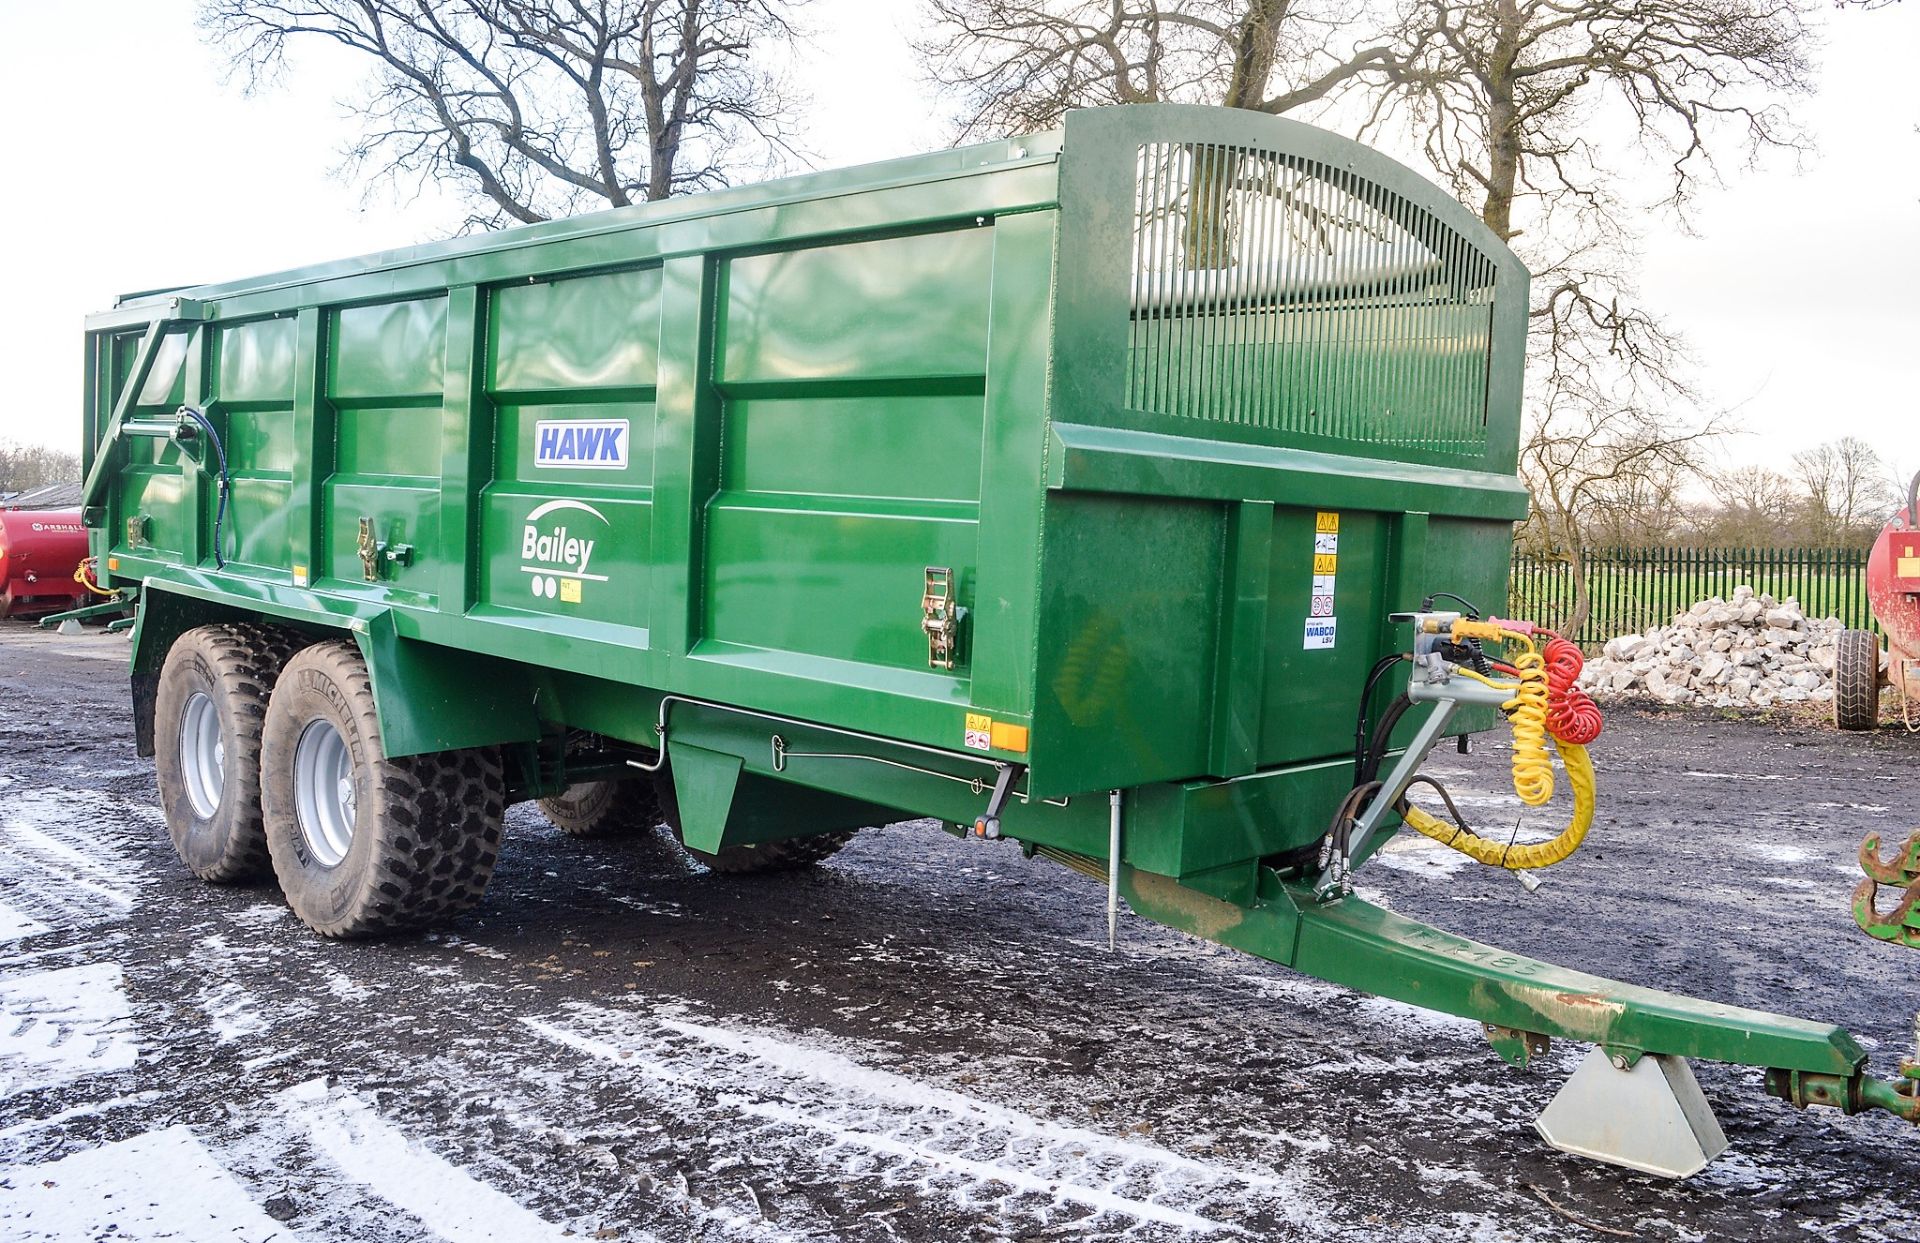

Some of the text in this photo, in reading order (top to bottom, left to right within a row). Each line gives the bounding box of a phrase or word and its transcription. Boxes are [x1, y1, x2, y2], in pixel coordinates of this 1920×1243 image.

[539, 428, 624, 461] HAWK
[522, 525, 594, 574] Bailey
[1306, 627, 1334, 637] WABCO
